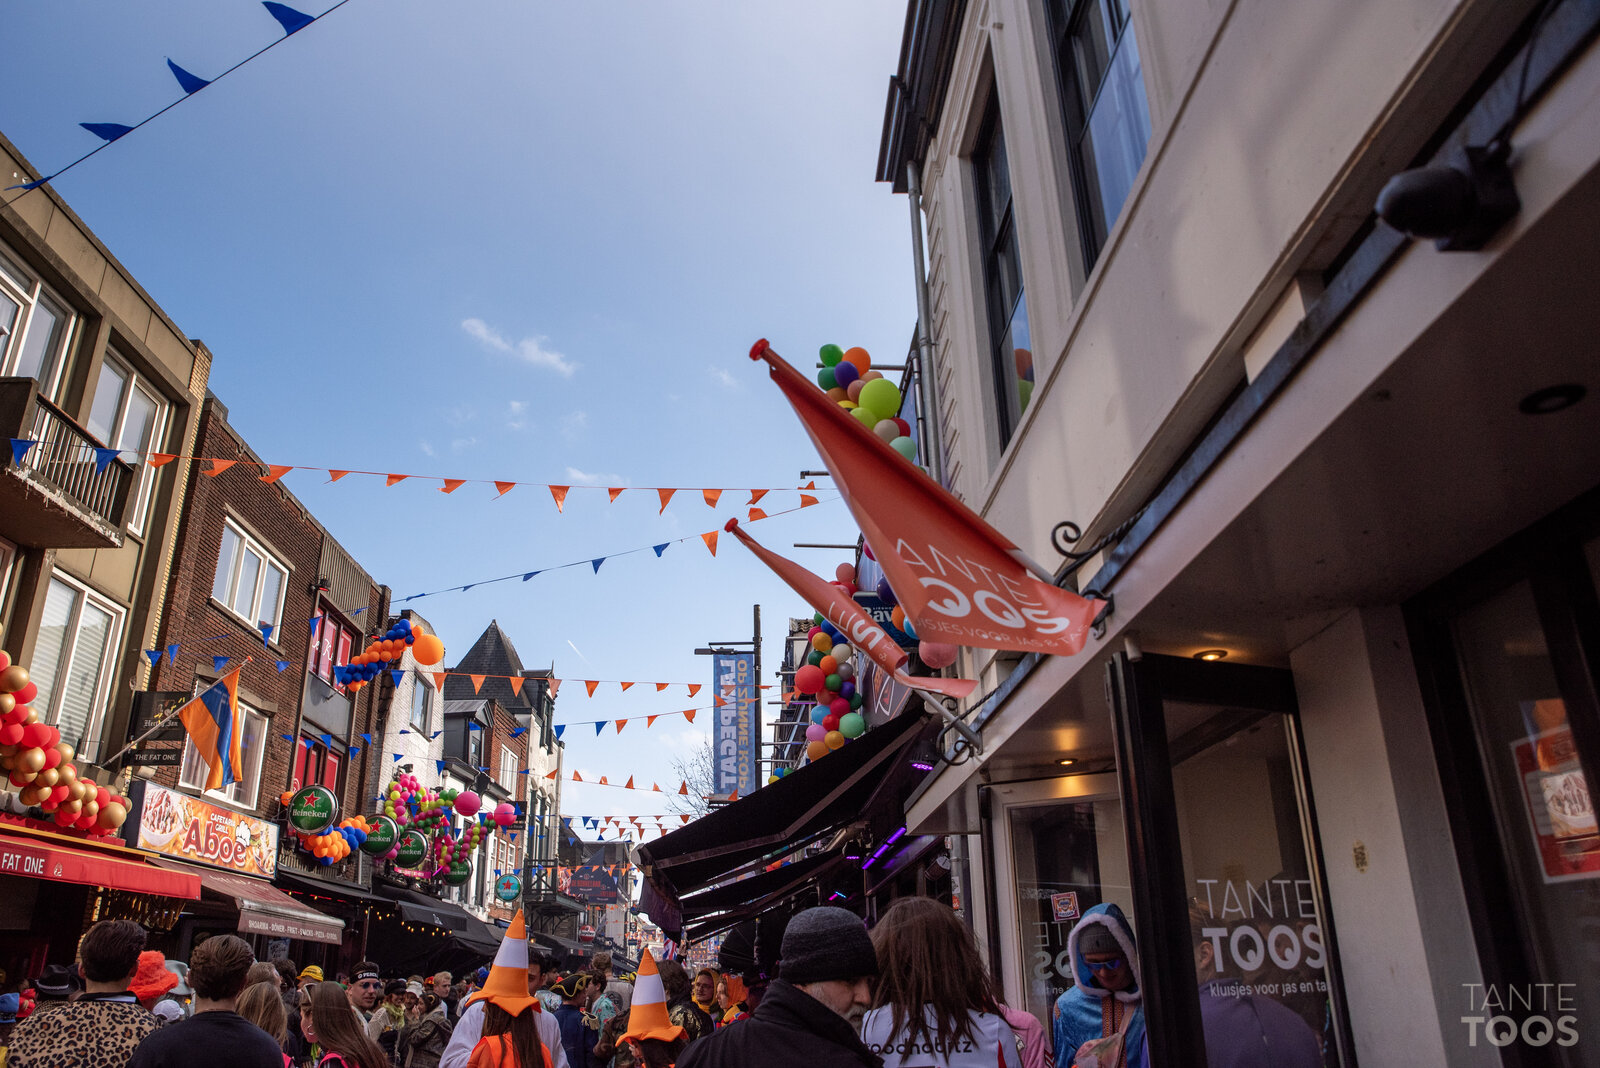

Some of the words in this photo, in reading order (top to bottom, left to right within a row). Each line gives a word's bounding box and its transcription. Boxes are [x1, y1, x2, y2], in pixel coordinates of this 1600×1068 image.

[896, 538, 1043, 606] ANTE
[918, 576, 1070, 634] OOS
[292, 808, 328, 818] Heineken
[182, 817, 247, 867] Aboe
[367, 835, 391, 843] ineken
[1, 852, 22, 871] FAT
[23, 856, 46, 875] ONE
[1196, 878, 1317, 919] TANTE
[1201, 923, 1328, 973] TOOS
[1209, 983, 1253, 1000] kluisjes
[1254, 983, 1279, 995] voor
[1280, 982, 1297, 997] jas
[1299, 982, 1314, 993] en
[1315, 979, 1328, 993] ta
[869, 1037, 972, 1055] oodhabitz
